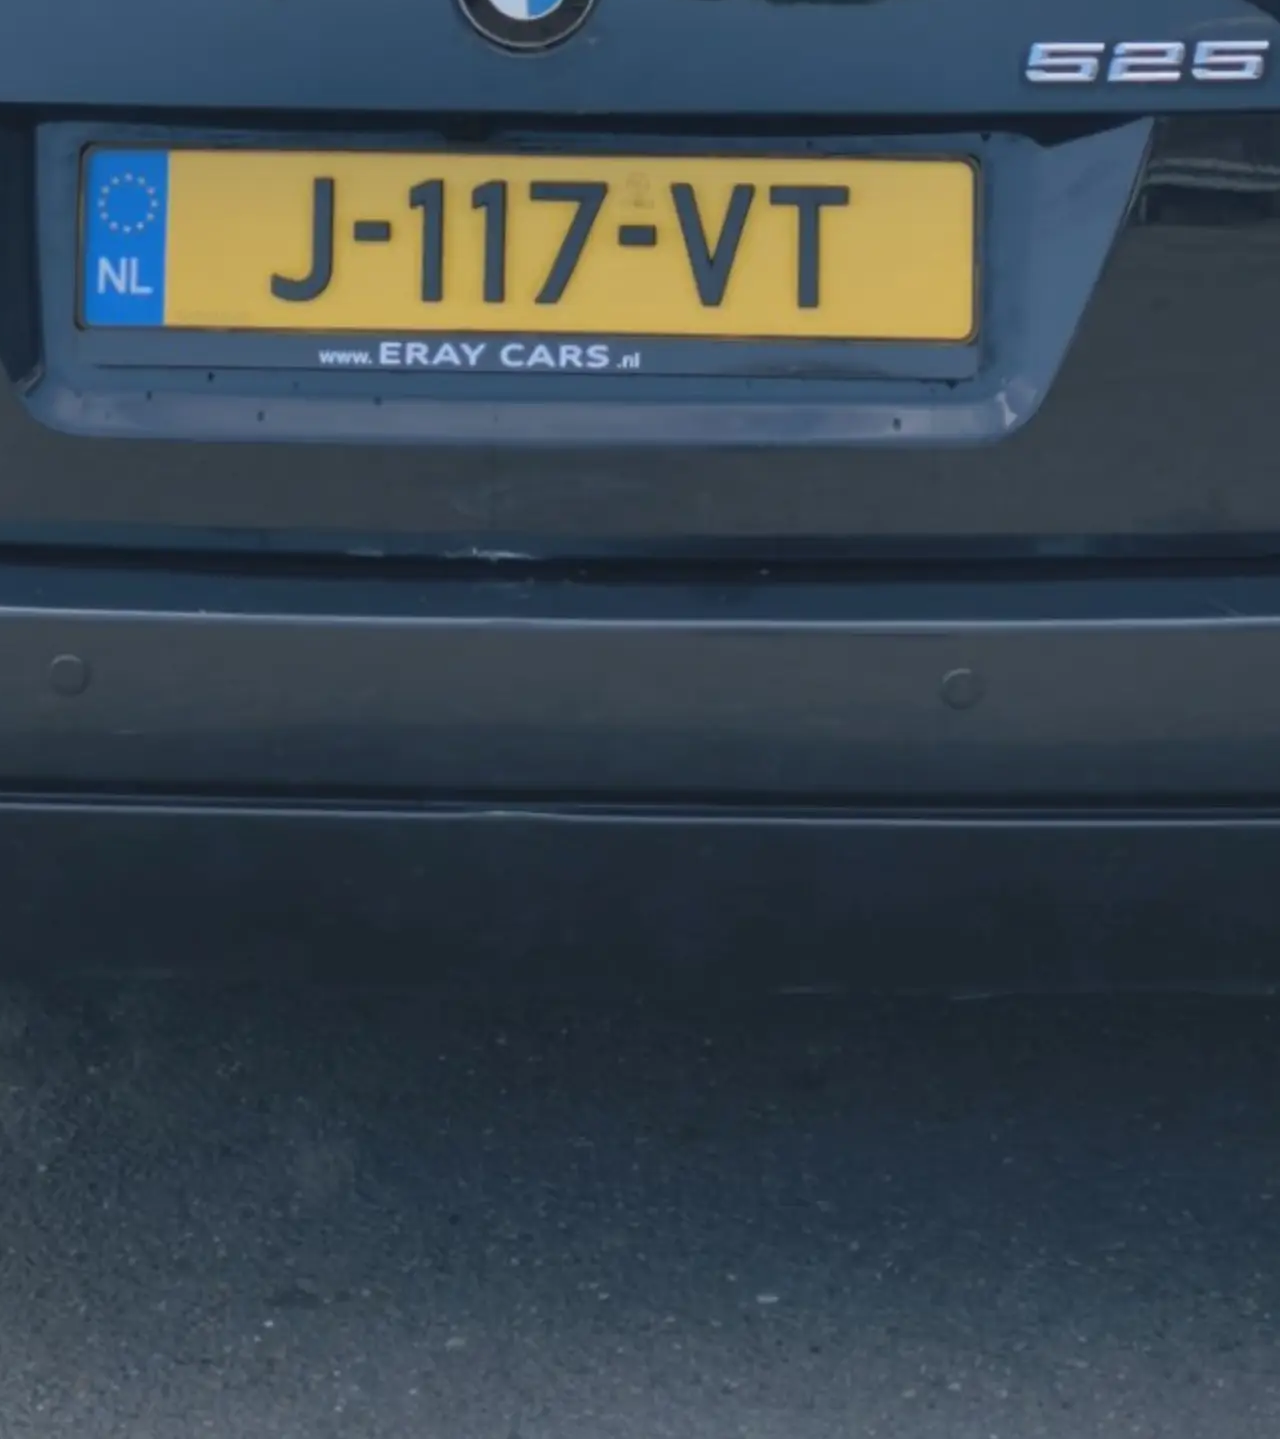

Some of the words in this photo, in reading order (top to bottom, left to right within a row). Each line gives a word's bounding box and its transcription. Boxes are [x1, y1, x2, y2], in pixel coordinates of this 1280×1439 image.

[1025, 40, 1270, 82] 525
[270, 176, 851, 310] J-117-VT
[96, 256, 154, 295] NL
[319, 350, 372, 365] www.
[379, 341, 487, 367] ERAY
[500, 343, 611, 368] CARS
[616, 353, 641, 369] .nl
